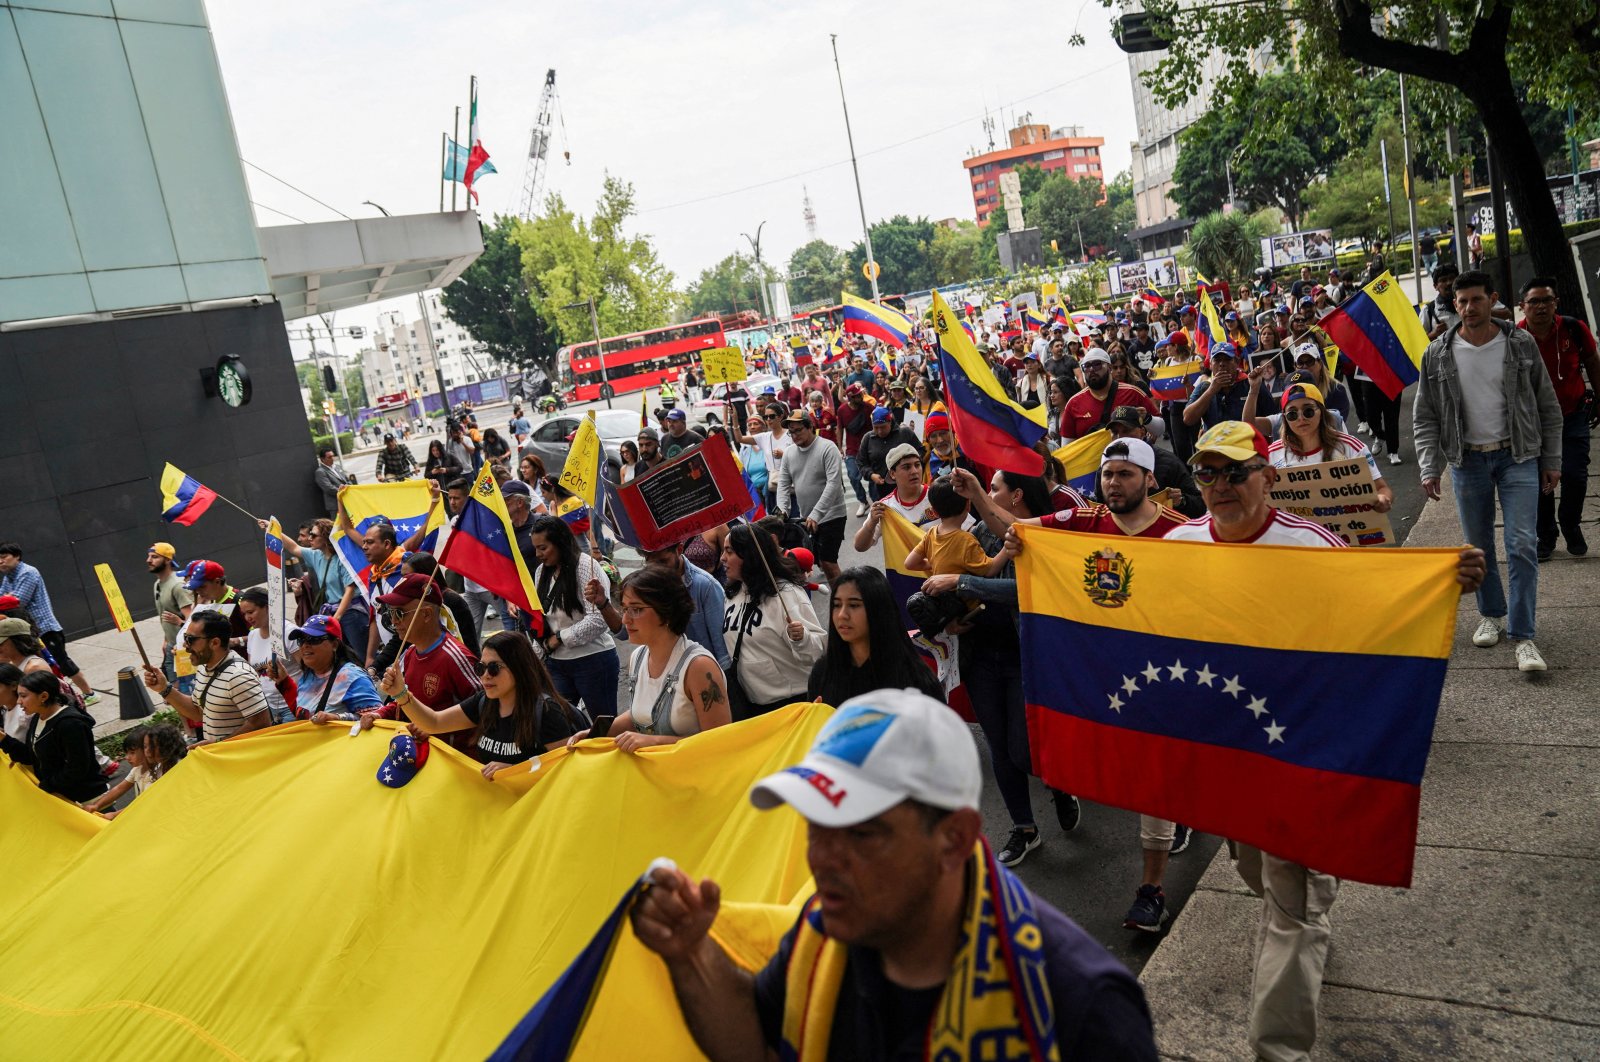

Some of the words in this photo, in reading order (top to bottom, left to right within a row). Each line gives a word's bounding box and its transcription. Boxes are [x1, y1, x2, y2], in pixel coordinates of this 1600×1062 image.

[1287, 468, 1322, 483] para
[1329, 463, 1361, 480] que
[1270, 488, 1310, 501] mejor
[1320, 482, 1374, 499] opción
[1347, 519, 1367, 530] de
[477, 735, 495, 752] STA
[493, 740, 501, 754] EL
[500, 742, 522, 756] FINAL
